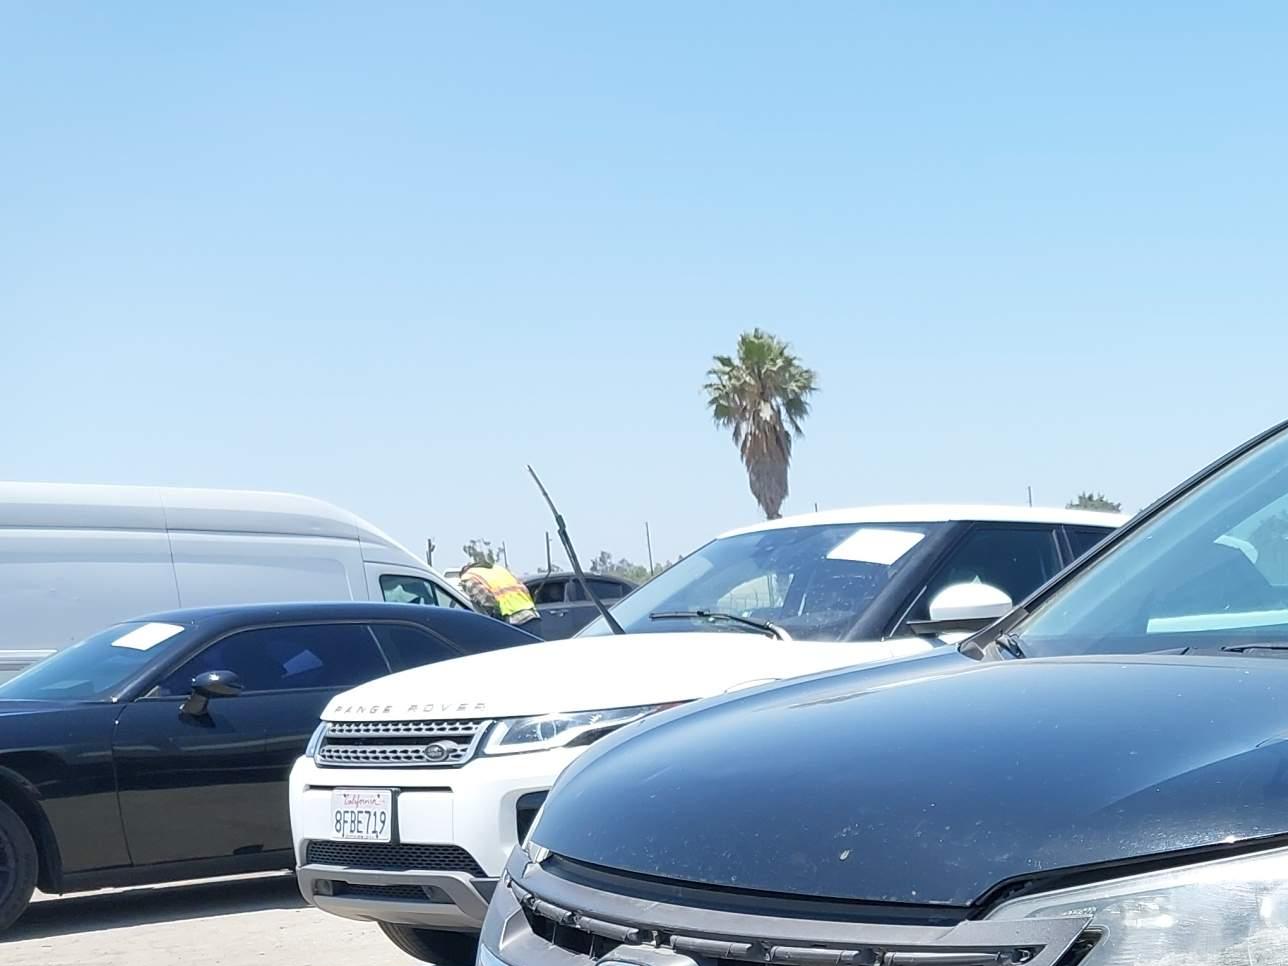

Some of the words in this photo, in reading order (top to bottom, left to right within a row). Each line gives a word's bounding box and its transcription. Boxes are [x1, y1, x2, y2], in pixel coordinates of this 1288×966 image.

[334, 705, 393, 714] RANGE
[407, 703, 486, 713] ROVER
[334, 810, 387, 834] 8FBE719
